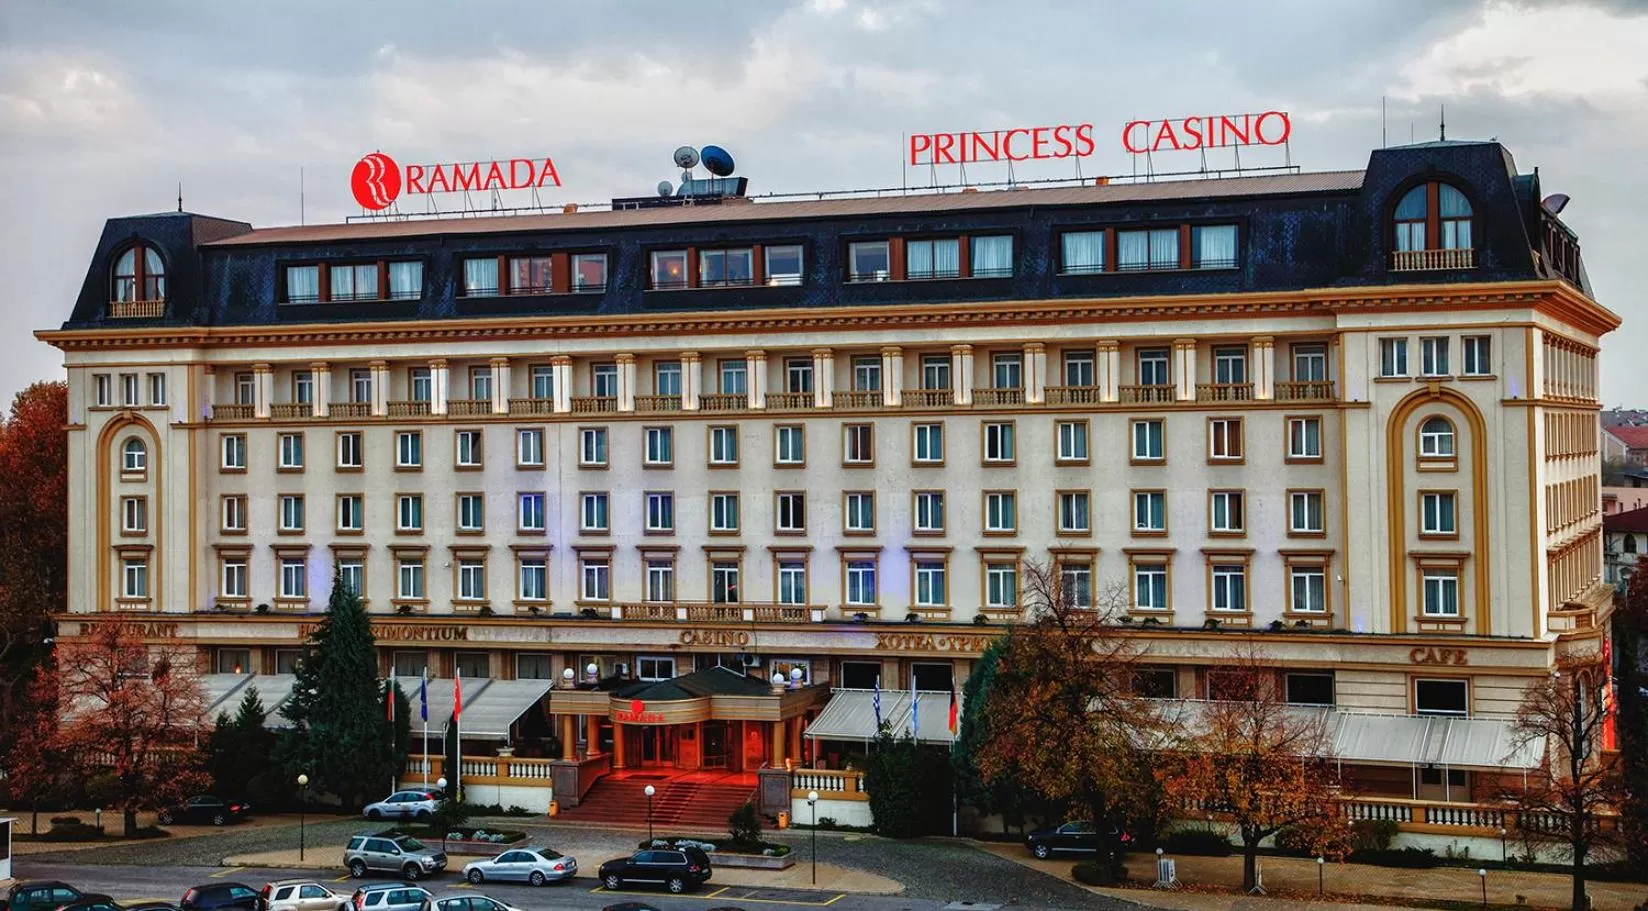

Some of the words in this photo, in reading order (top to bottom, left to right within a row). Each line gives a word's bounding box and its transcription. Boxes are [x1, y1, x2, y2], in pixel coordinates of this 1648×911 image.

[911, 125, 1095, 165] PRINCESS
[1122, 112, 1291, 154] CASINO
[406, 158, 561, 194] RAMADA
[368, 623, 468, 641] RIMONTIUM
[679, 630, 749, 645] CASINO
[1409, 646, 1469, 664] CAFE
